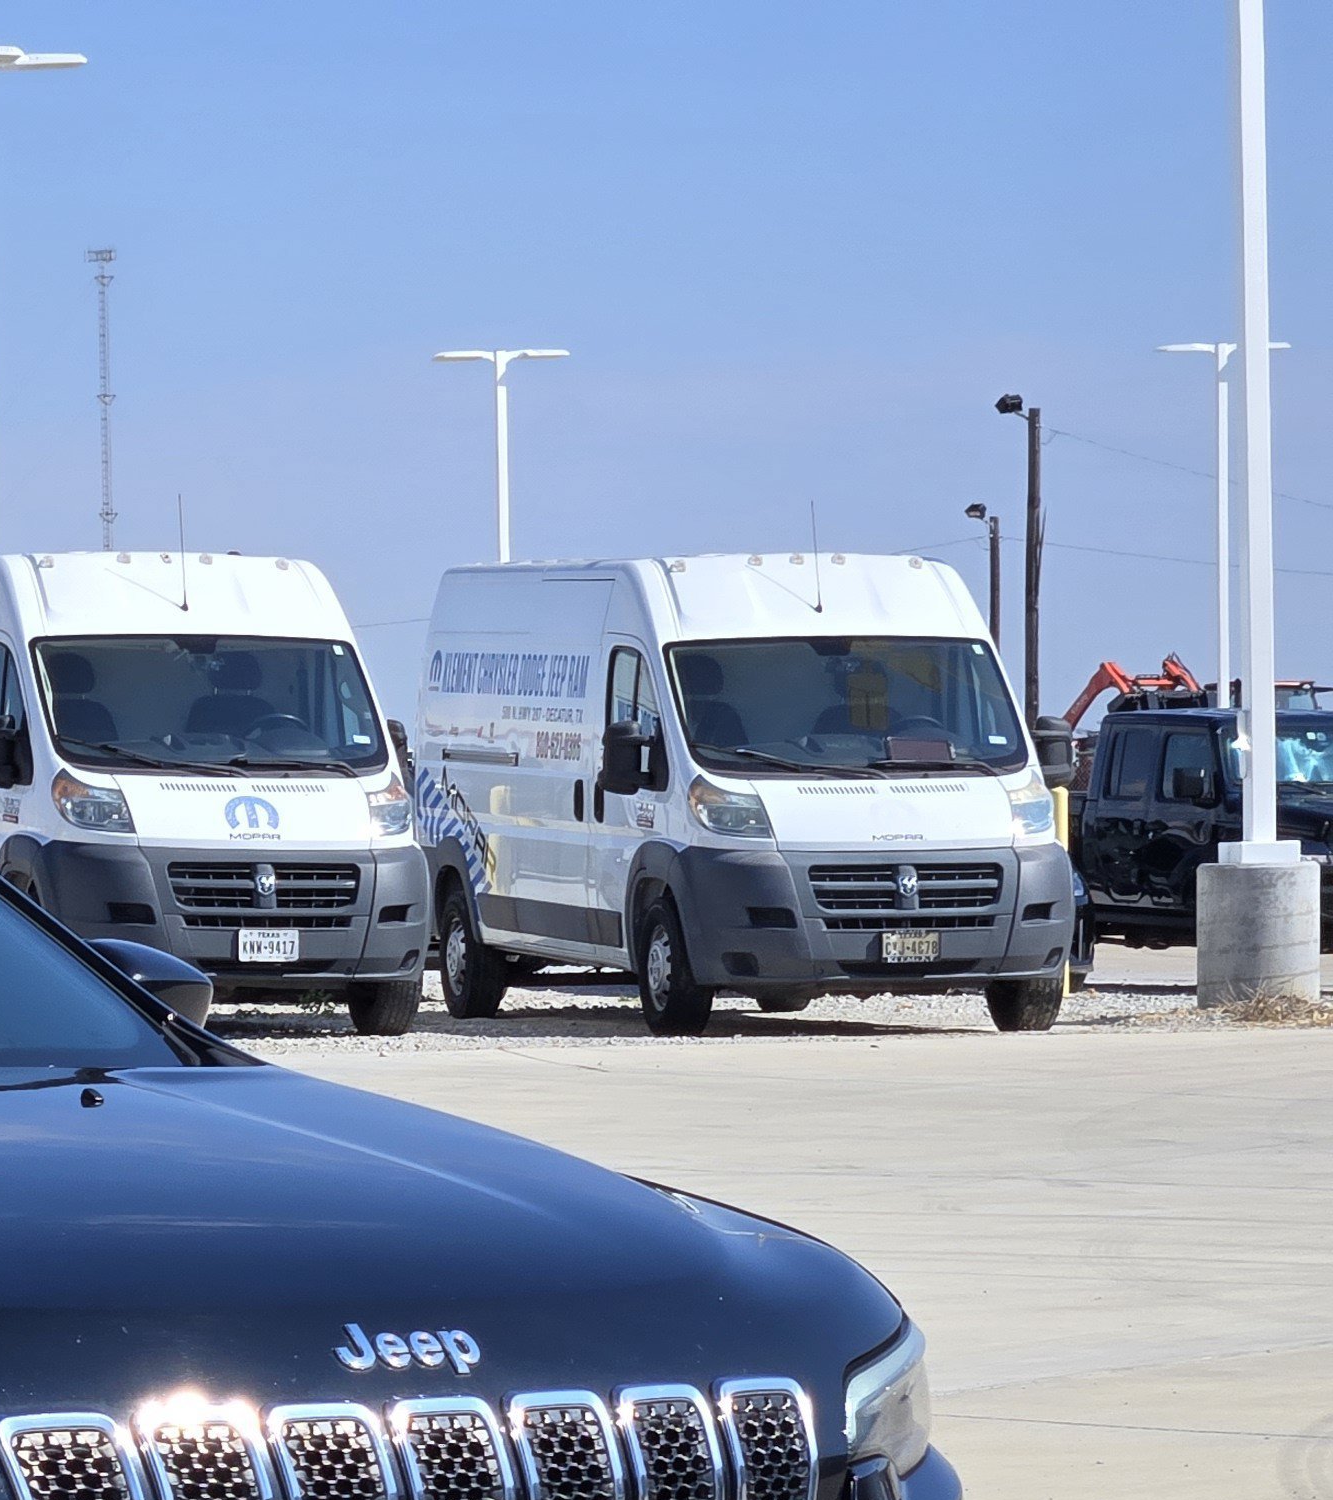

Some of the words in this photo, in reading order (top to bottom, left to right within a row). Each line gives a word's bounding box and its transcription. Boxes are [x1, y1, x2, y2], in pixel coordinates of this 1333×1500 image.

[441, 652, 479, 694] KLEMENT
[477, 653, 520, 696] CHRYSLER
[517, 654, 548, 697] DODGE
[546, 654, 569, 698] JEEP
[566, 655, 590, 699] RAM
[229, 833, 281, 841] MOPAR
[334, 1322, 481, 1376] Jeep
